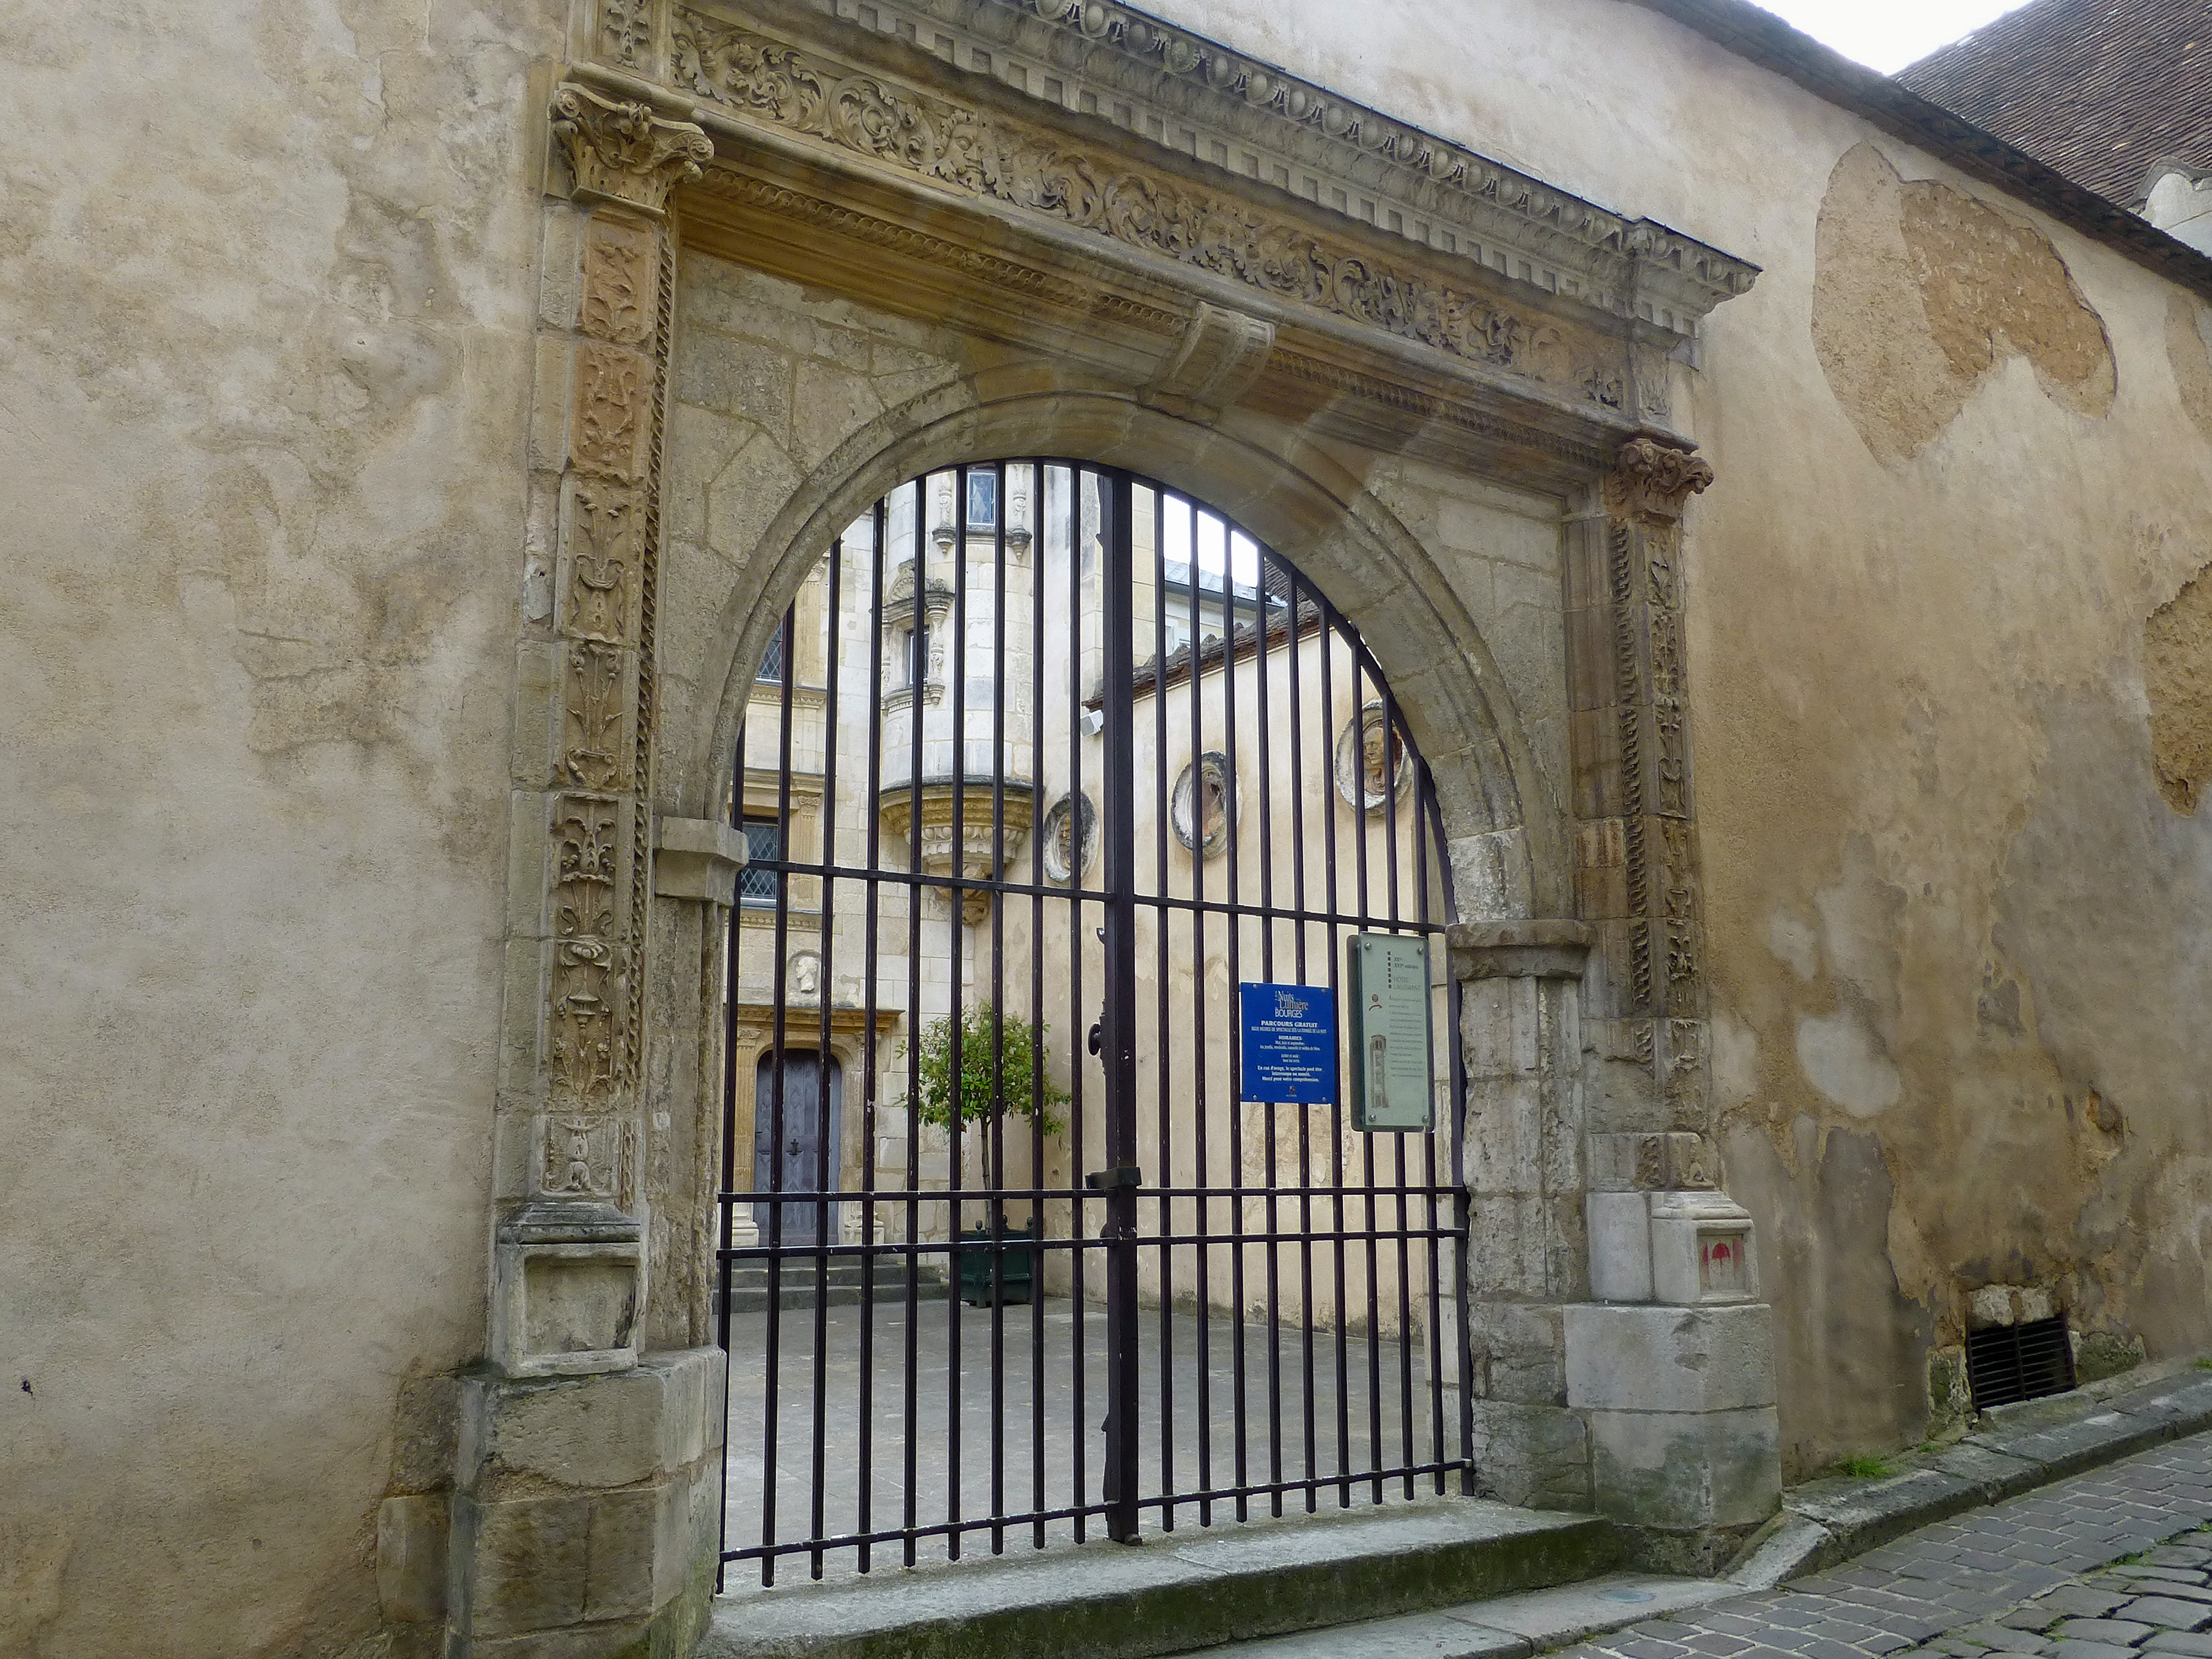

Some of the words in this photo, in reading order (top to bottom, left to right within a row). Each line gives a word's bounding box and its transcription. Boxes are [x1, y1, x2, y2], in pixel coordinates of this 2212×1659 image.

[1278, 990, 1294, 1001] Nuits
[1280, 999, 1308, 1010] Lumière
[1275, 1009, 1302, 1018] BOURGES
